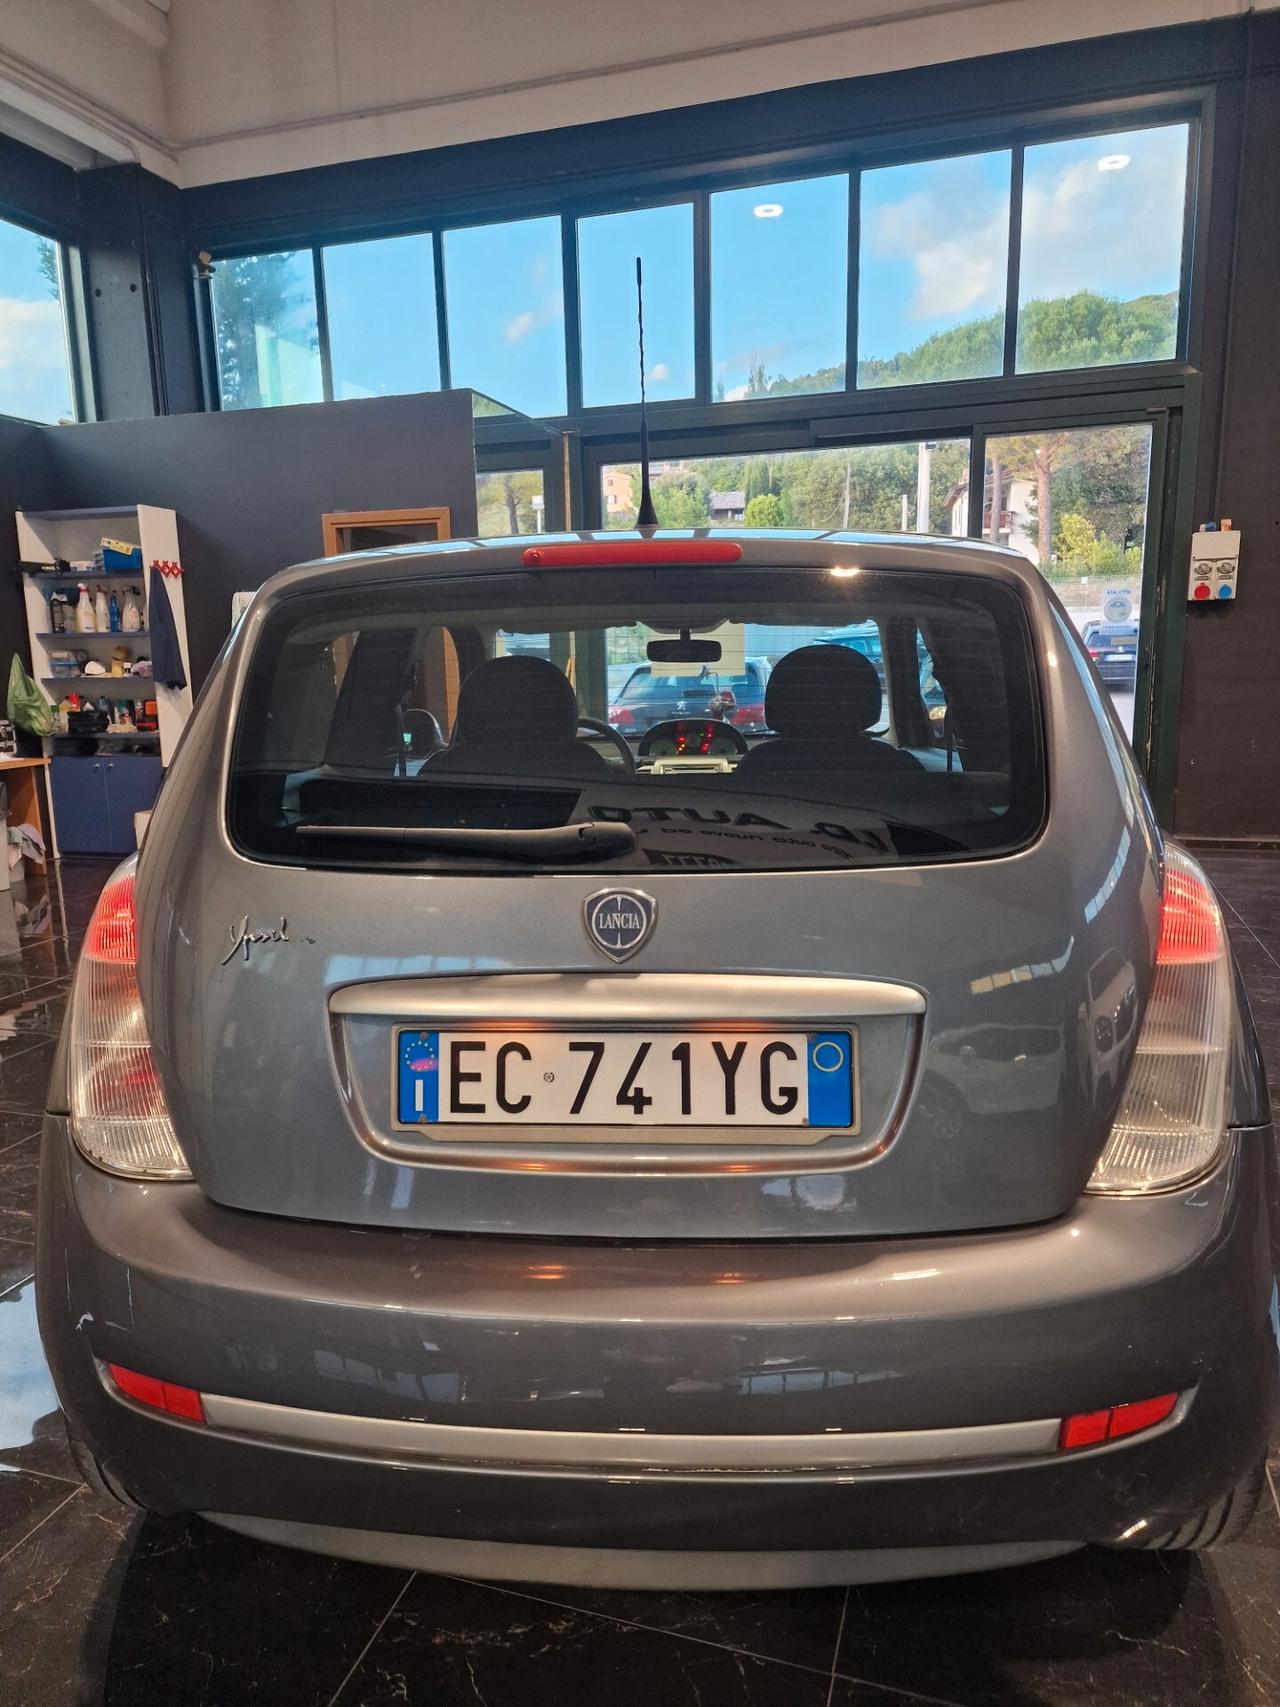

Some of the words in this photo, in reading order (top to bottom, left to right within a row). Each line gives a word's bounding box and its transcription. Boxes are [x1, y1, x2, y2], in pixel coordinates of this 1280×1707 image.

[598, 912, 641, 930] LANCIA
[450, 1041, 532, 1114] EC
[568, 1041, 799, 1115] 741YG
